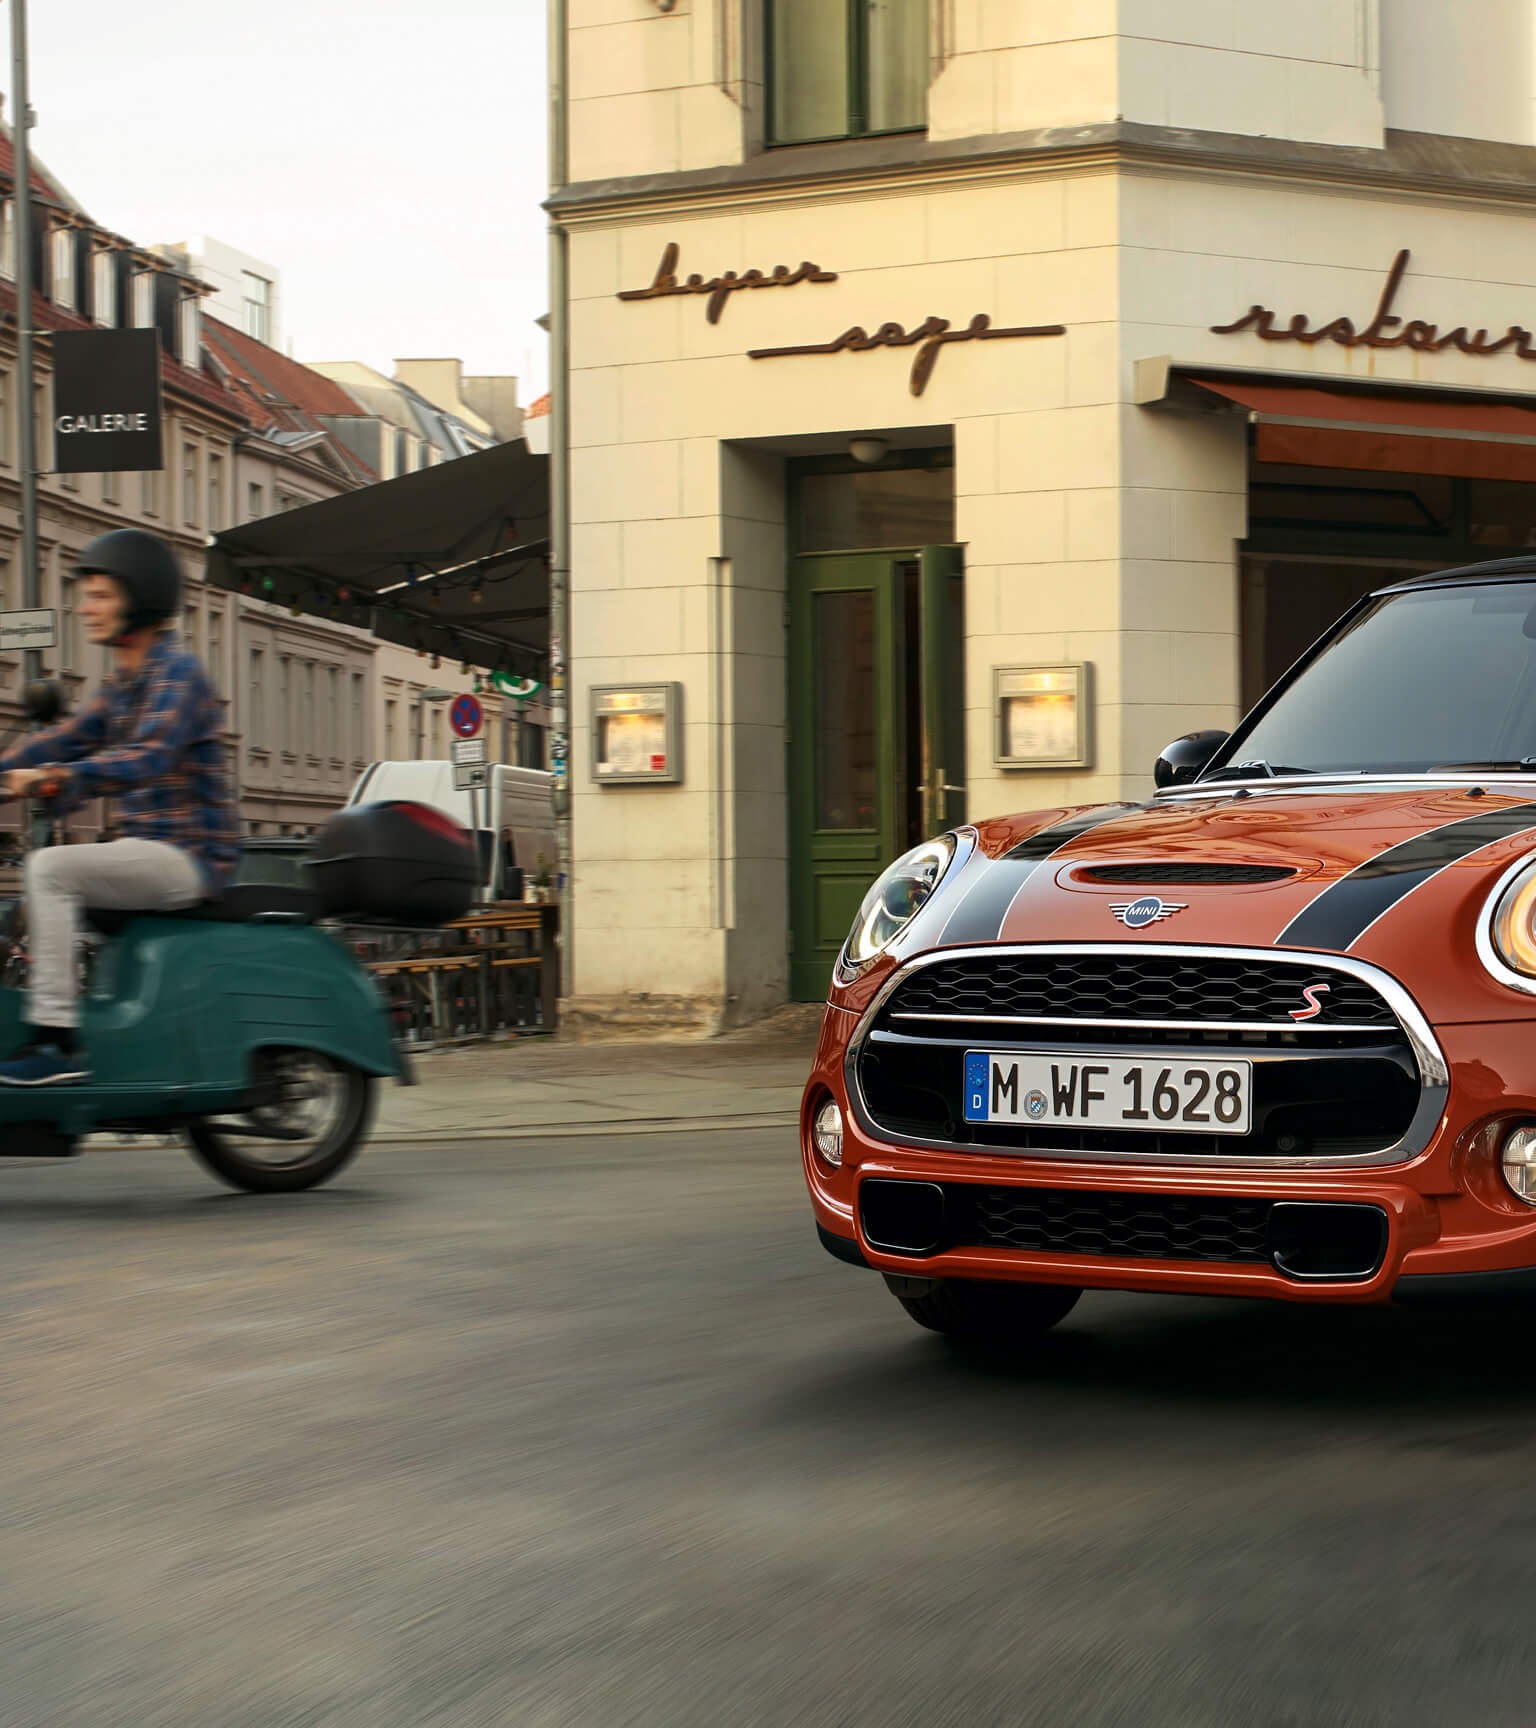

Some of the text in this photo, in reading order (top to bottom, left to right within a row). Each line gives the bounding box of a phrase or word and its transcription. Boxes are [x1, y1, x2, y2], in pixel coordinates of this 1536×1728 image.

[55, 413, 147, 433] GALERIE
[1128, 906, 1157, 915] MINI
[1288, 983, 1331, 1021] S
[972, 1094, 982, 1109] D
[991, 1062, 1243, 1123] M WF 1628
